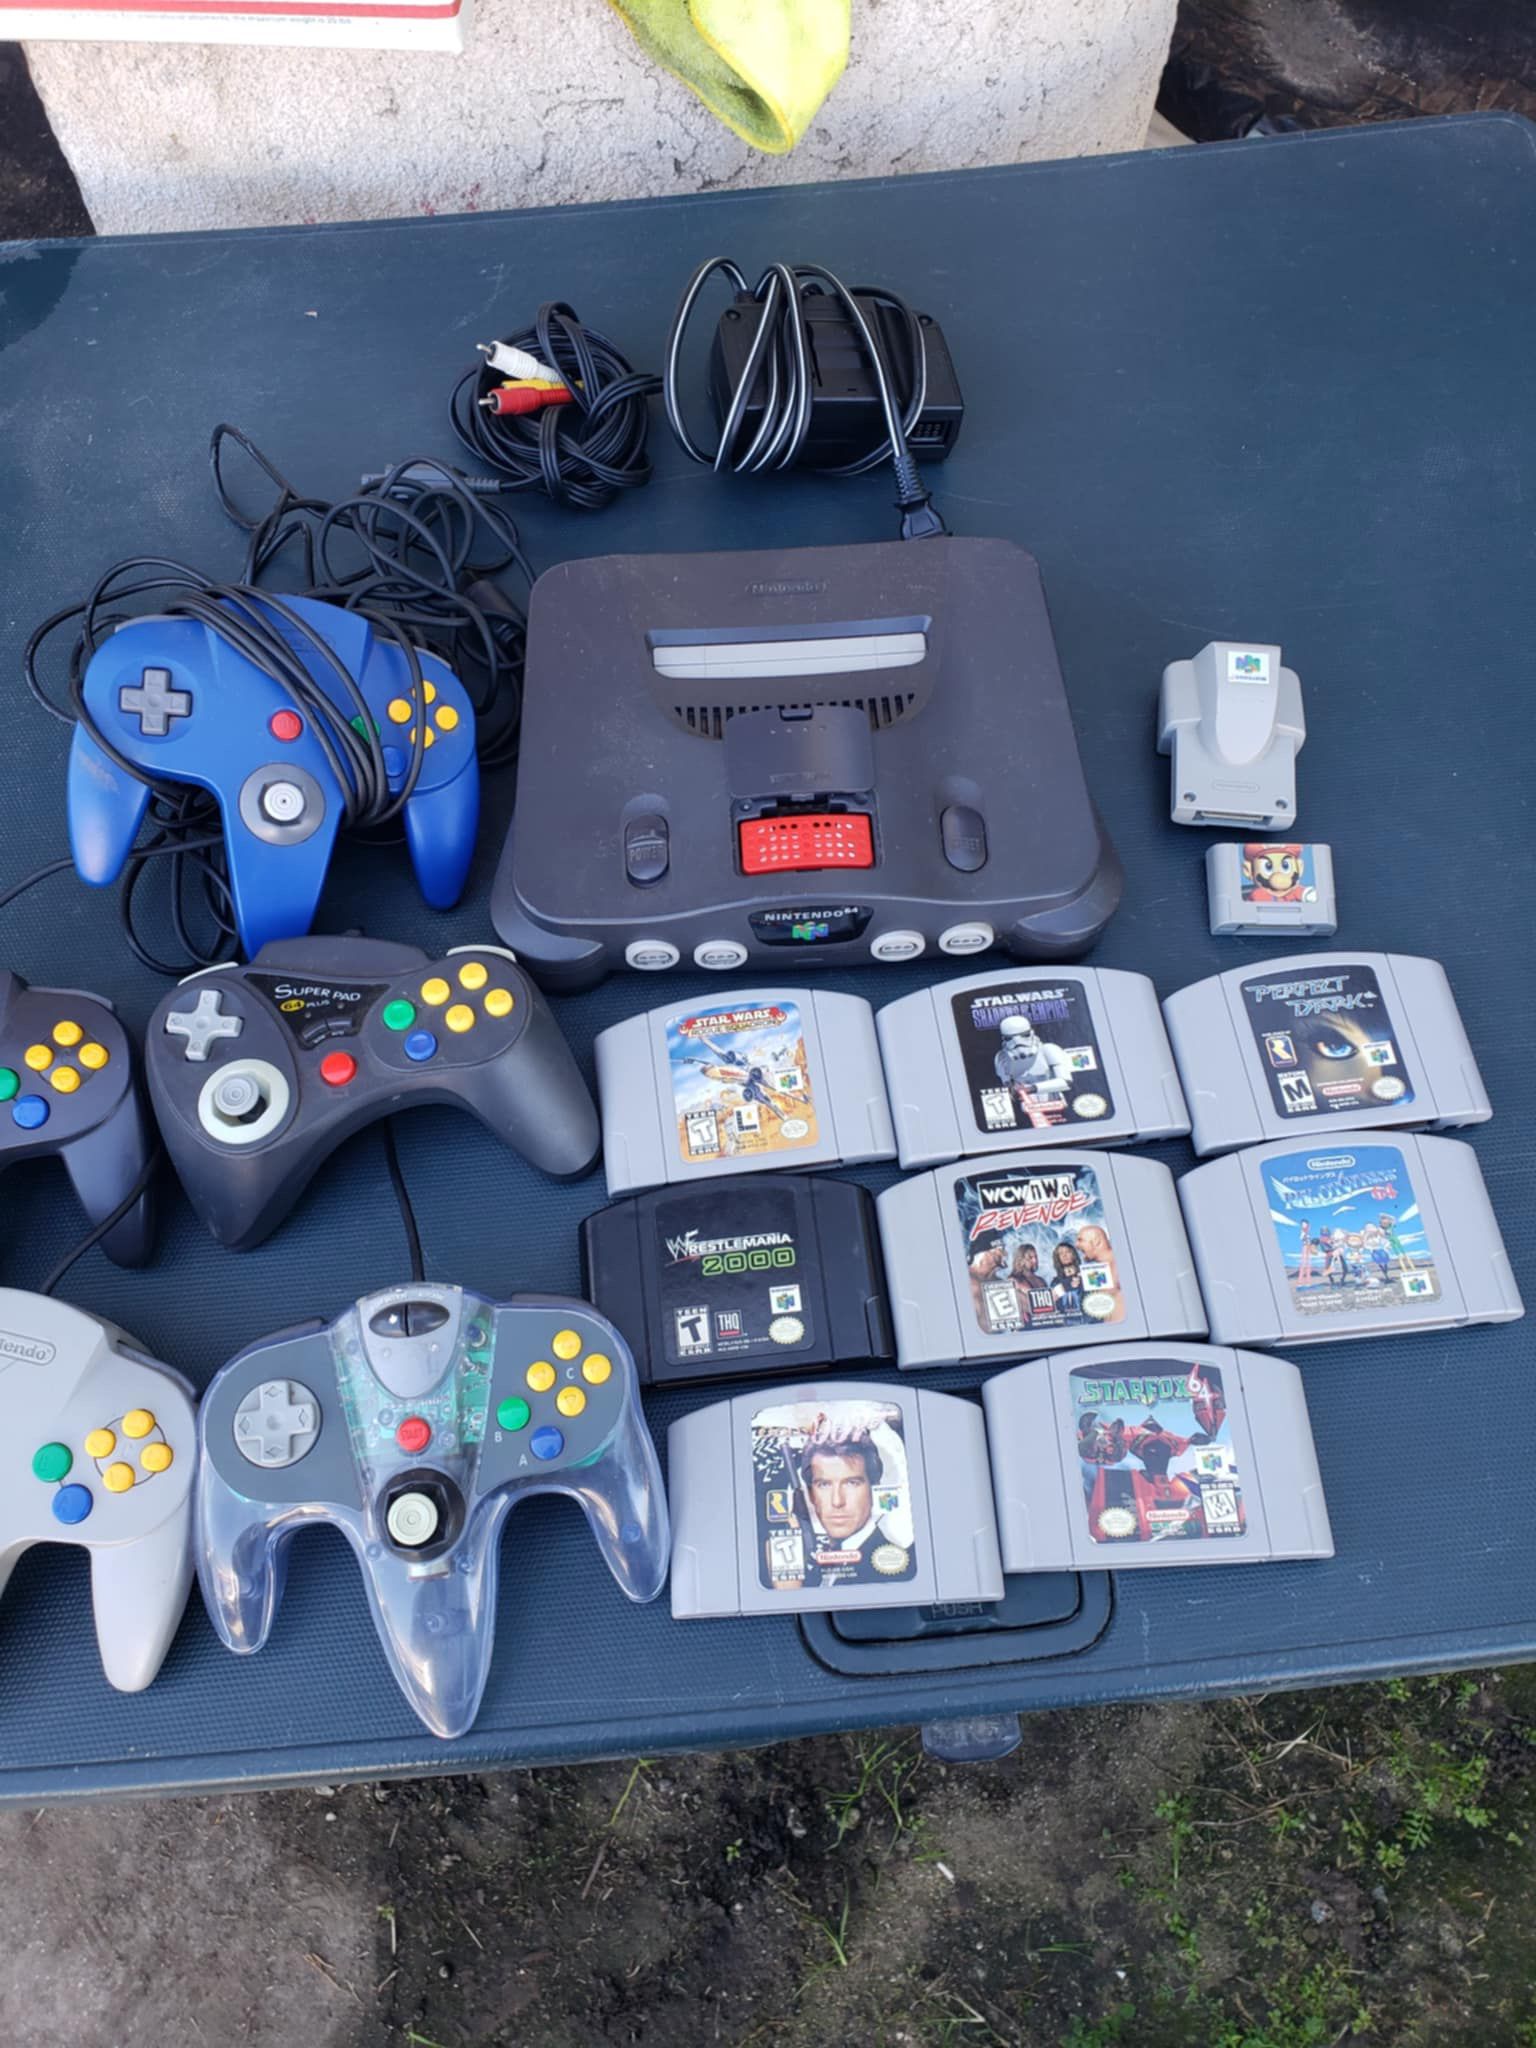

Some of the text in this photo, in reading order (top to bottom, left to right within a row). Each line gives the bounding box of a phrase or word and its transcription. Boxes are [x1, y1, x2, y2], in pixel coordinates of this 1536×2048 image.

[274, 984, 361, 1002] SUPER PAD
[970, 988, 1065, 1008] STAR WARS
[692, 1008, 771, 1028] STAR WARS
[1282, 1078, 1312, 1103] M
[970, 1190, 1095, 1241] REVENGE
[702, 1247, 796, 1277] 2000
[992, 1291, 1014, 1317] E
[680, 1316, 703, 1343] T
[717, 1313, 740, 1331] THQ
[565, 1368, 576, 1380] C
[494, 1431, 503, 1443] B
[519, 1453, 528, 1466] A
[776, 1539, 794, 1563] T
